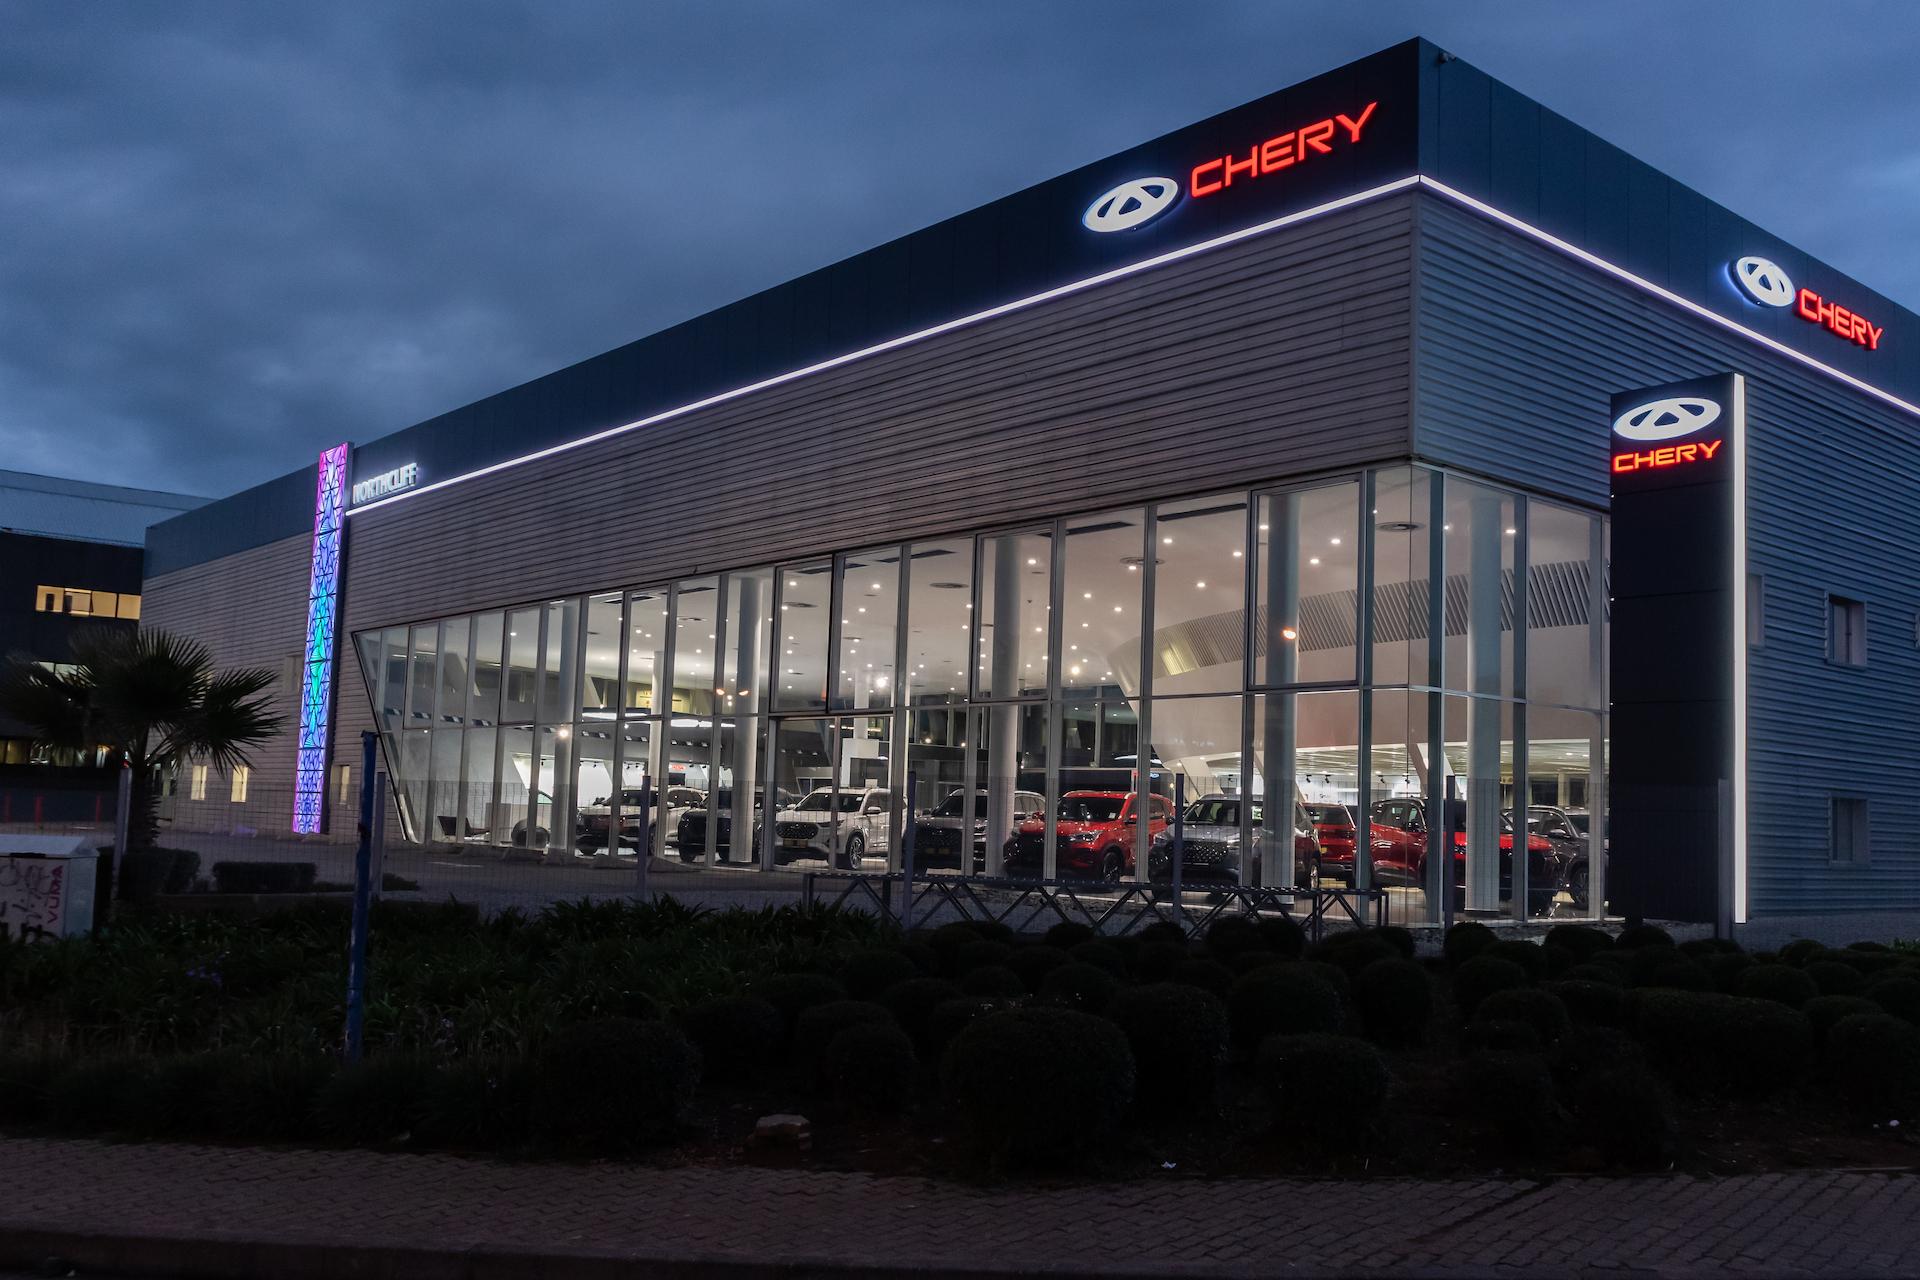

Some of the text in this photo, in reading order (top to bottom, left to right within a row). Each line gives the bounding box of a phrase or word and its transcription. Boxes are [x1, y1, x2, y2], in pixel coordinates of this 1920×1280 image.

[1191, 101, 1379, 198] CHERY
[1798, 287, 1884, 351] CHERY
[1613, 440, 1722, 473] CHERY
[352, 462, 418, 505] NORTHCLIFF
